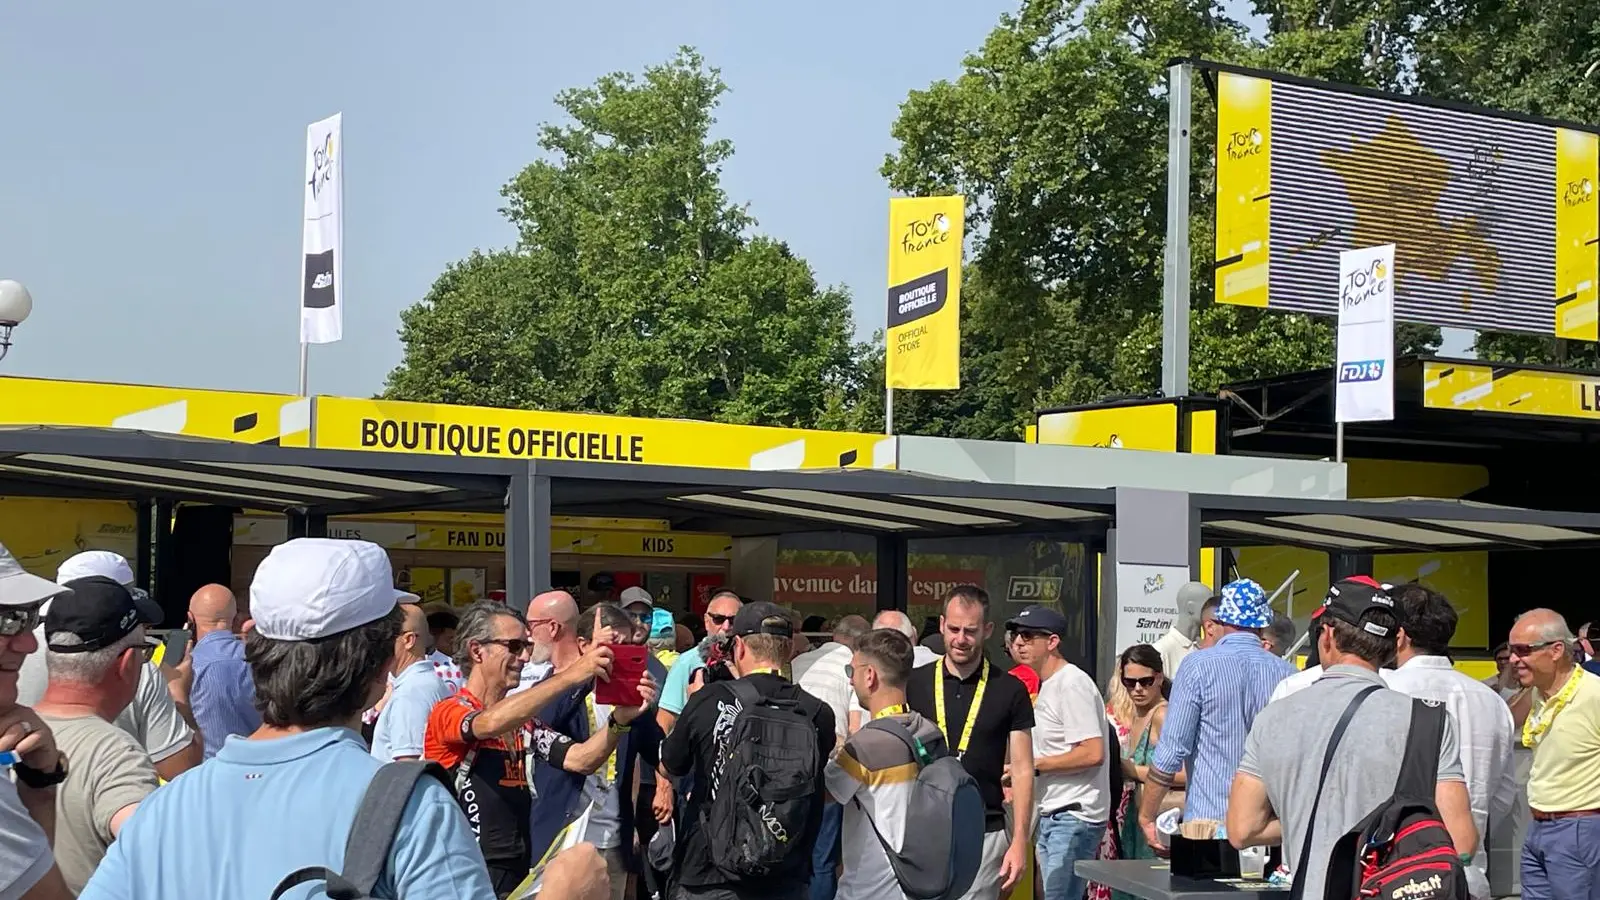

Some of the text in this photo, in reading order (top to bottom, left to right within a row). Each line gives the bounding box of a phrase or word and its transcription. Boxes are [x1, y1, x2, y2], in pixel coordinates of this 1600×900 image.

[898, 282, 937, 304] BOUTIQUE
[898, 292, 937, 315] OFFICIELLE
[898, 324, 928, 343] OFFICIAL
[897, 338, 920, 355] STORE
[1340, 364, 1368, 380] FDJ
[361, 418, 643, 462] BOUTIQUE OFFICIELLE
[447, 530, 505, 546] FAN DU
[642, 537, 674, 552] KIDS
[1011, 581, 1042, 597] FDJ
[1136, 618, 1173, 629] Santini
